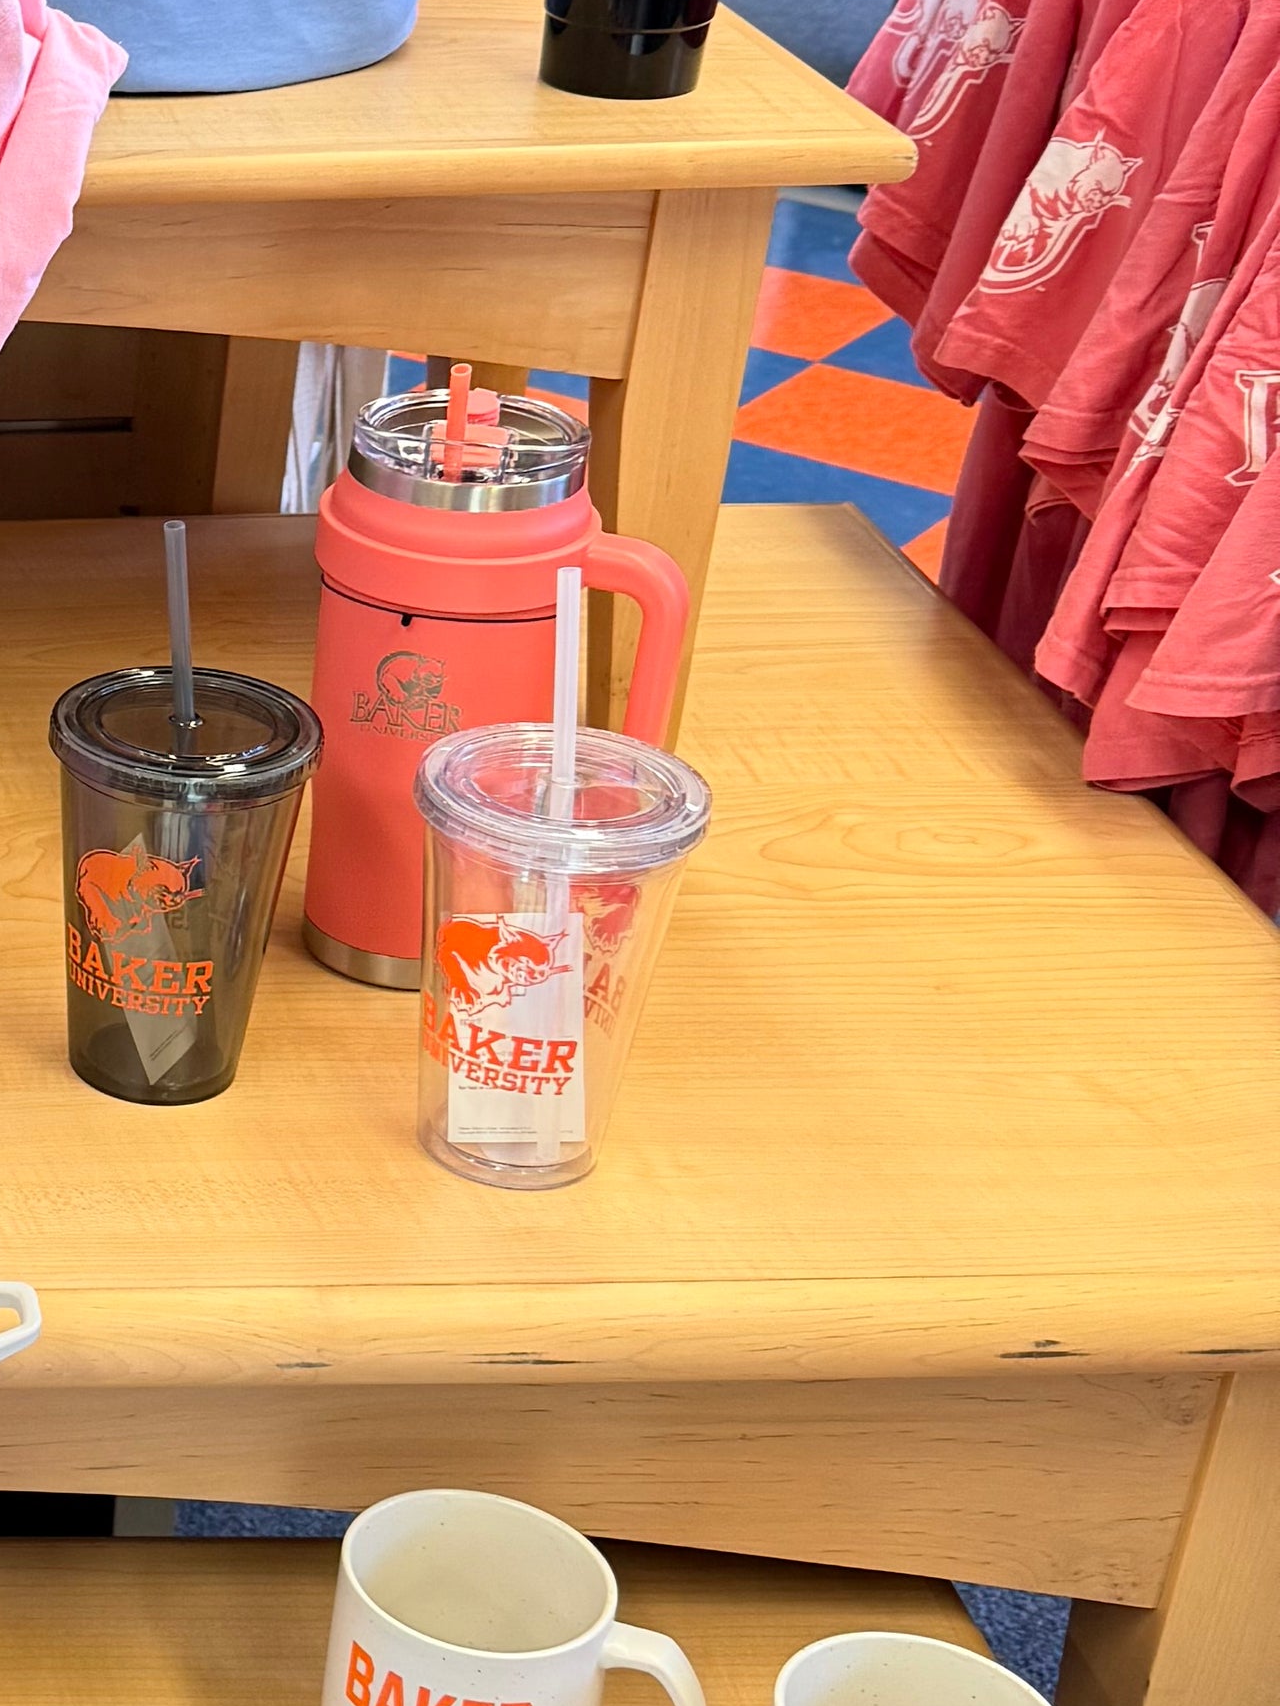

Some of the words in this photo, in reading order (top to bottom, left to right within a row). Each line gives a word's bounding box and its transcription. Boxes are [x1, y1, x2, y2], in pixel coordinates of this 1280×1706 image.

[350, 691, 462, 736] BAKER
[67, 921, 215, 995] BAKER
[68, 956, 211, 1017] UNIVERSITY
[422, 988, 578, 1074] BAKER
[423, 1031, 572, 1097] UNIVERSITY
